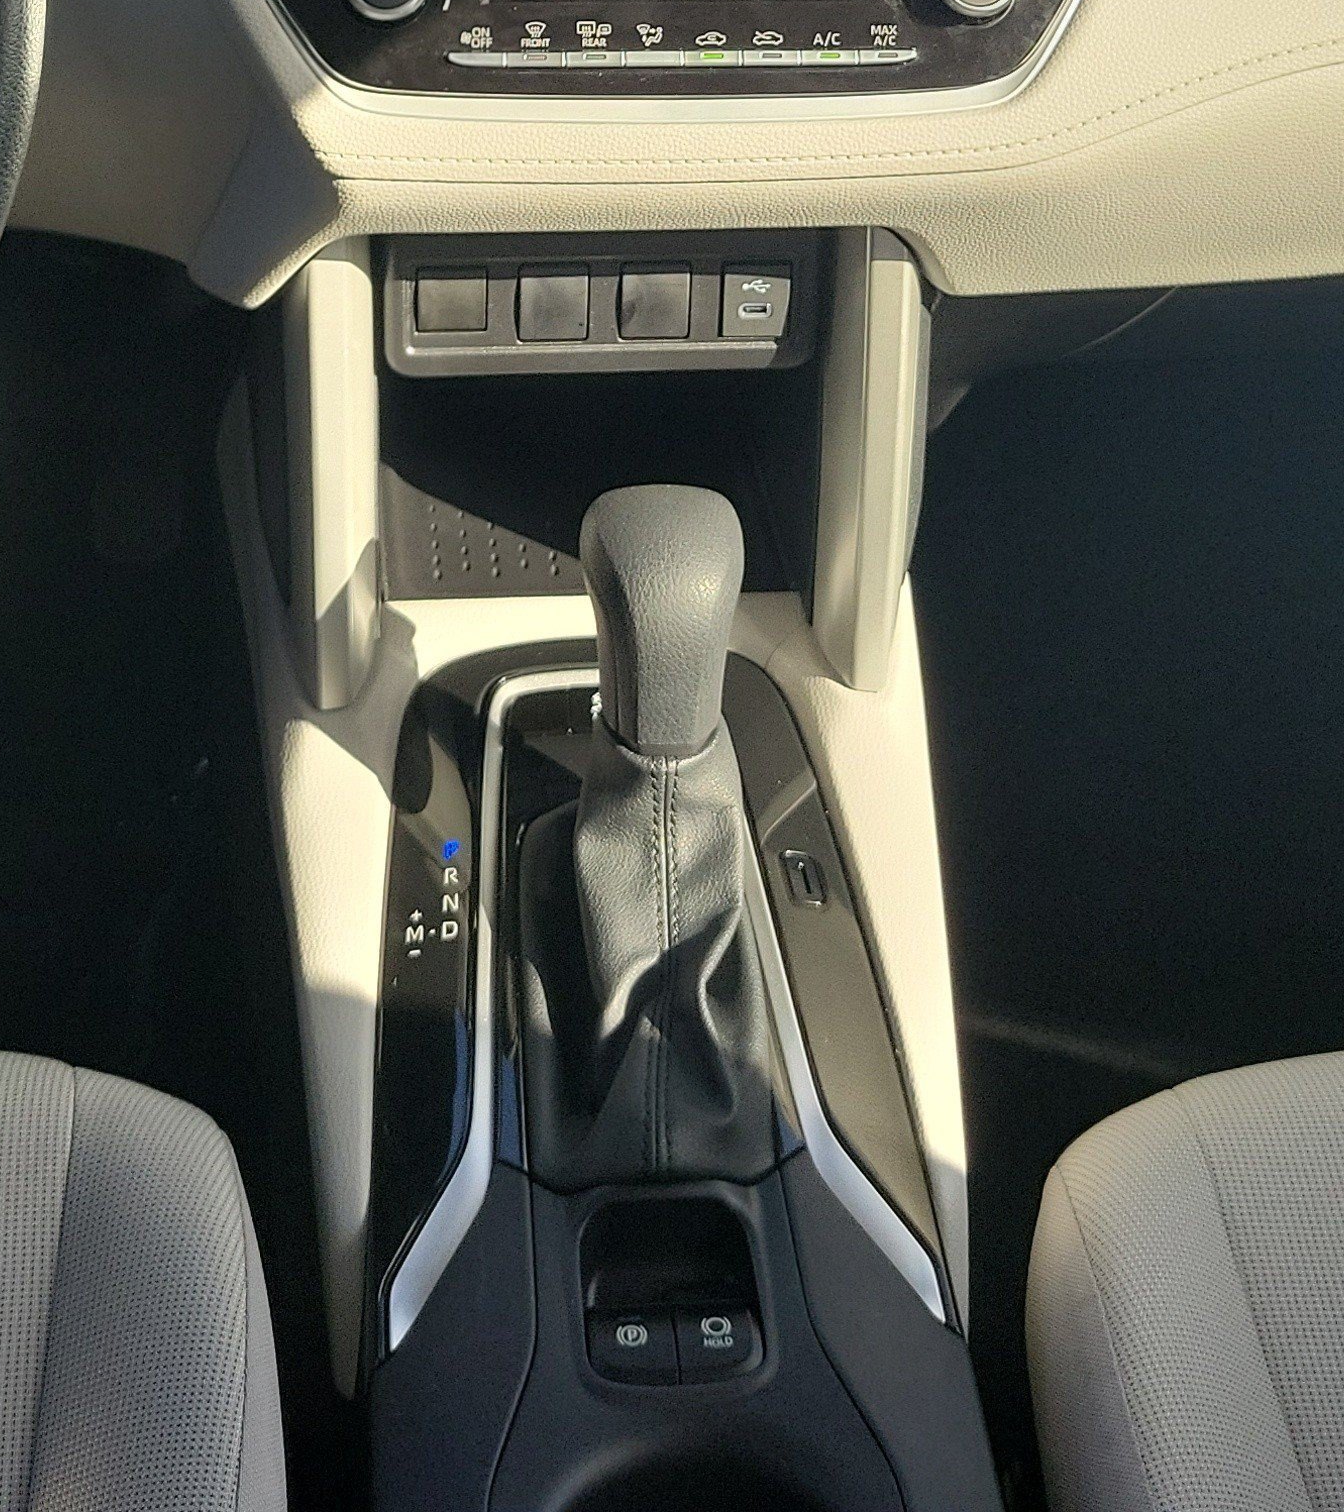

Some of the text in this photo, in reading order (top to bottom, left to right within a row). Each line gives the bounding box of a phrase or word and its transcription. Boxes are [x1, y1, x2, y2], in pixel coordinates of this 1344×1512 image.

[471, 26, 491, 37] ON
[870, 24, 898, 36] MAX
[471, 37, 493, 48] OFF
[520, 38, 550, 48] FRONT
[582, 38, 607, 48] REAR
[812, 32, 841, 46] A/C
[873, 35, 898, 46] A/C
[442, 839, 460, 861] P
[444, 867, 459, 886] R
[442, 892, 459, 912] N
[405, 925, 425, 945] M
[441, 921, 459, 941] D
[703, 1337, 733, 1349] HOLD
